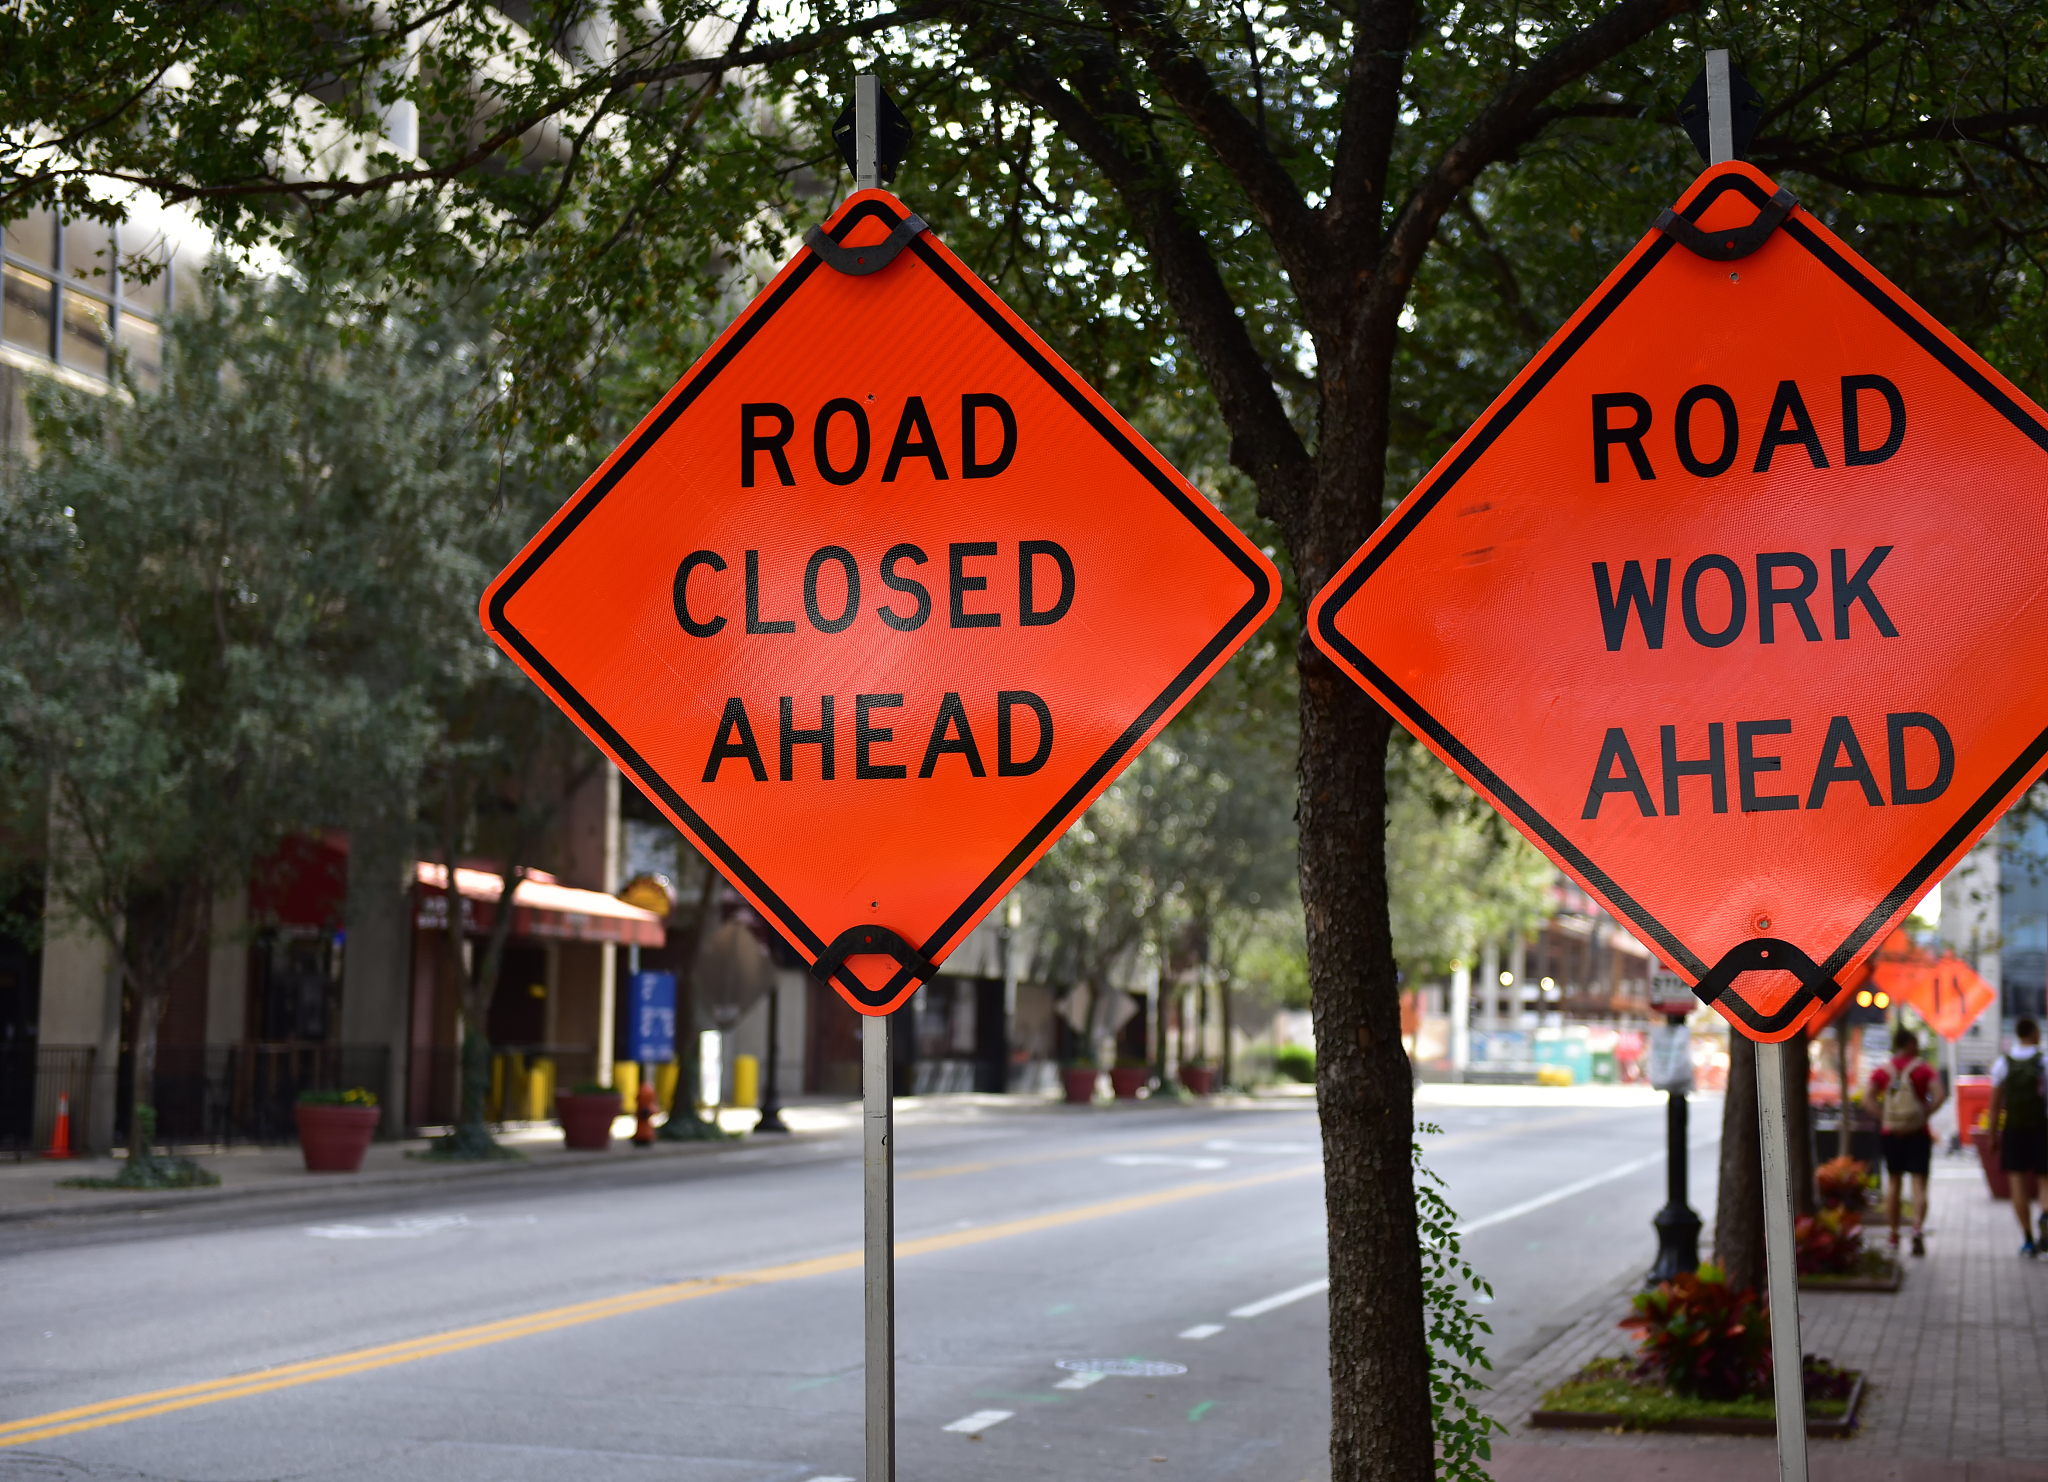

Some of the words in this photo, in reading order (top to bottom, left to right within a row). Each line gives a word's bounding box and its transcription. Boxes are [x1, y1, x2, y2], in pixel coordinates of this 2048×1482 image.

[741, 392, 1018, 488] ROAD
[1592, 373, 1907, 484] ROAD
[673, 540, 1076, 639] CLOSED
[1592, 545, 1901, 652] WORK
[702, 690, 1054, 783] AHEAD
[1581, 711, 1956, 820] AHEAD
